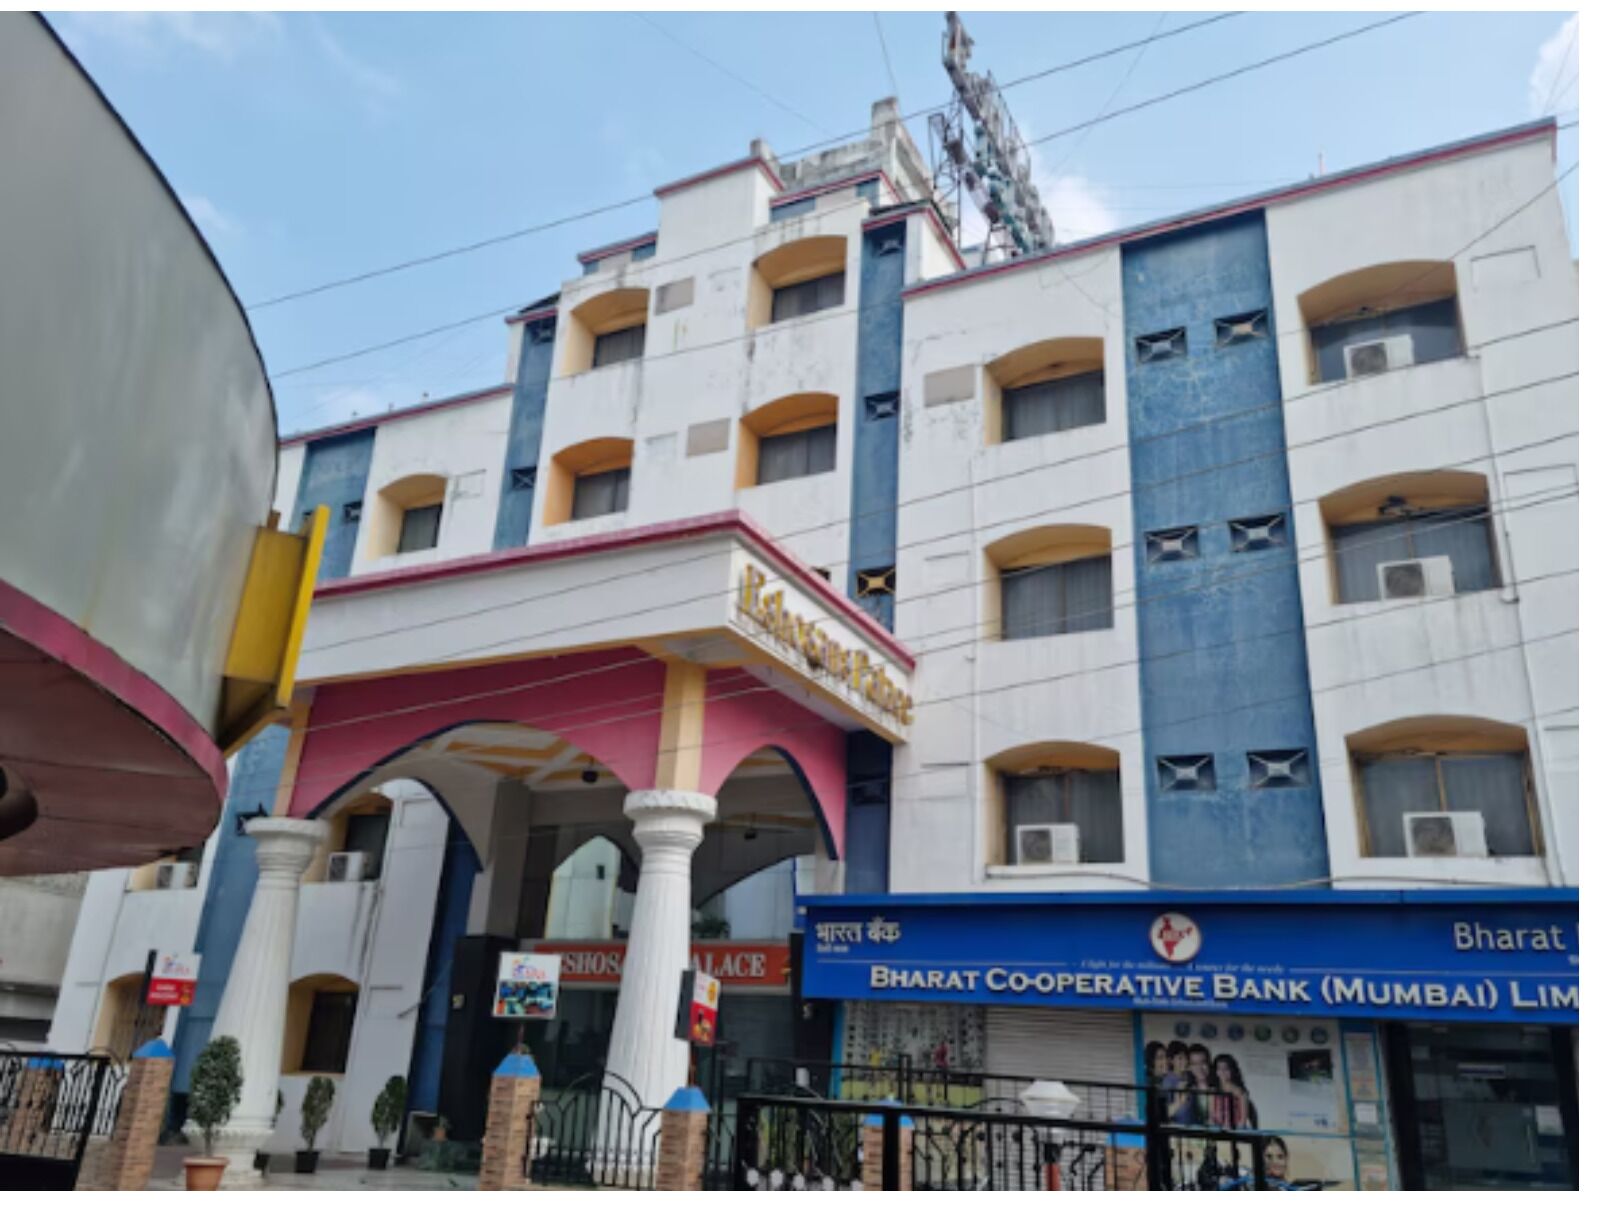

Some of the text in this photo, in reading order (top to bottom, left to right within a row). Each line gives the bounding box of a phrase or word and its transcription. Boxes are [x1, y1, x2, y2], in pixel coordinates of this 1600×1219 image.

[815, 922, 863, 943] भारत
[1454, 922, 1566, 950] Bharat
[869, 965, 1579, 1010] BHARAT CO-OPERATIVE BANK (MUMBAI) LIM
